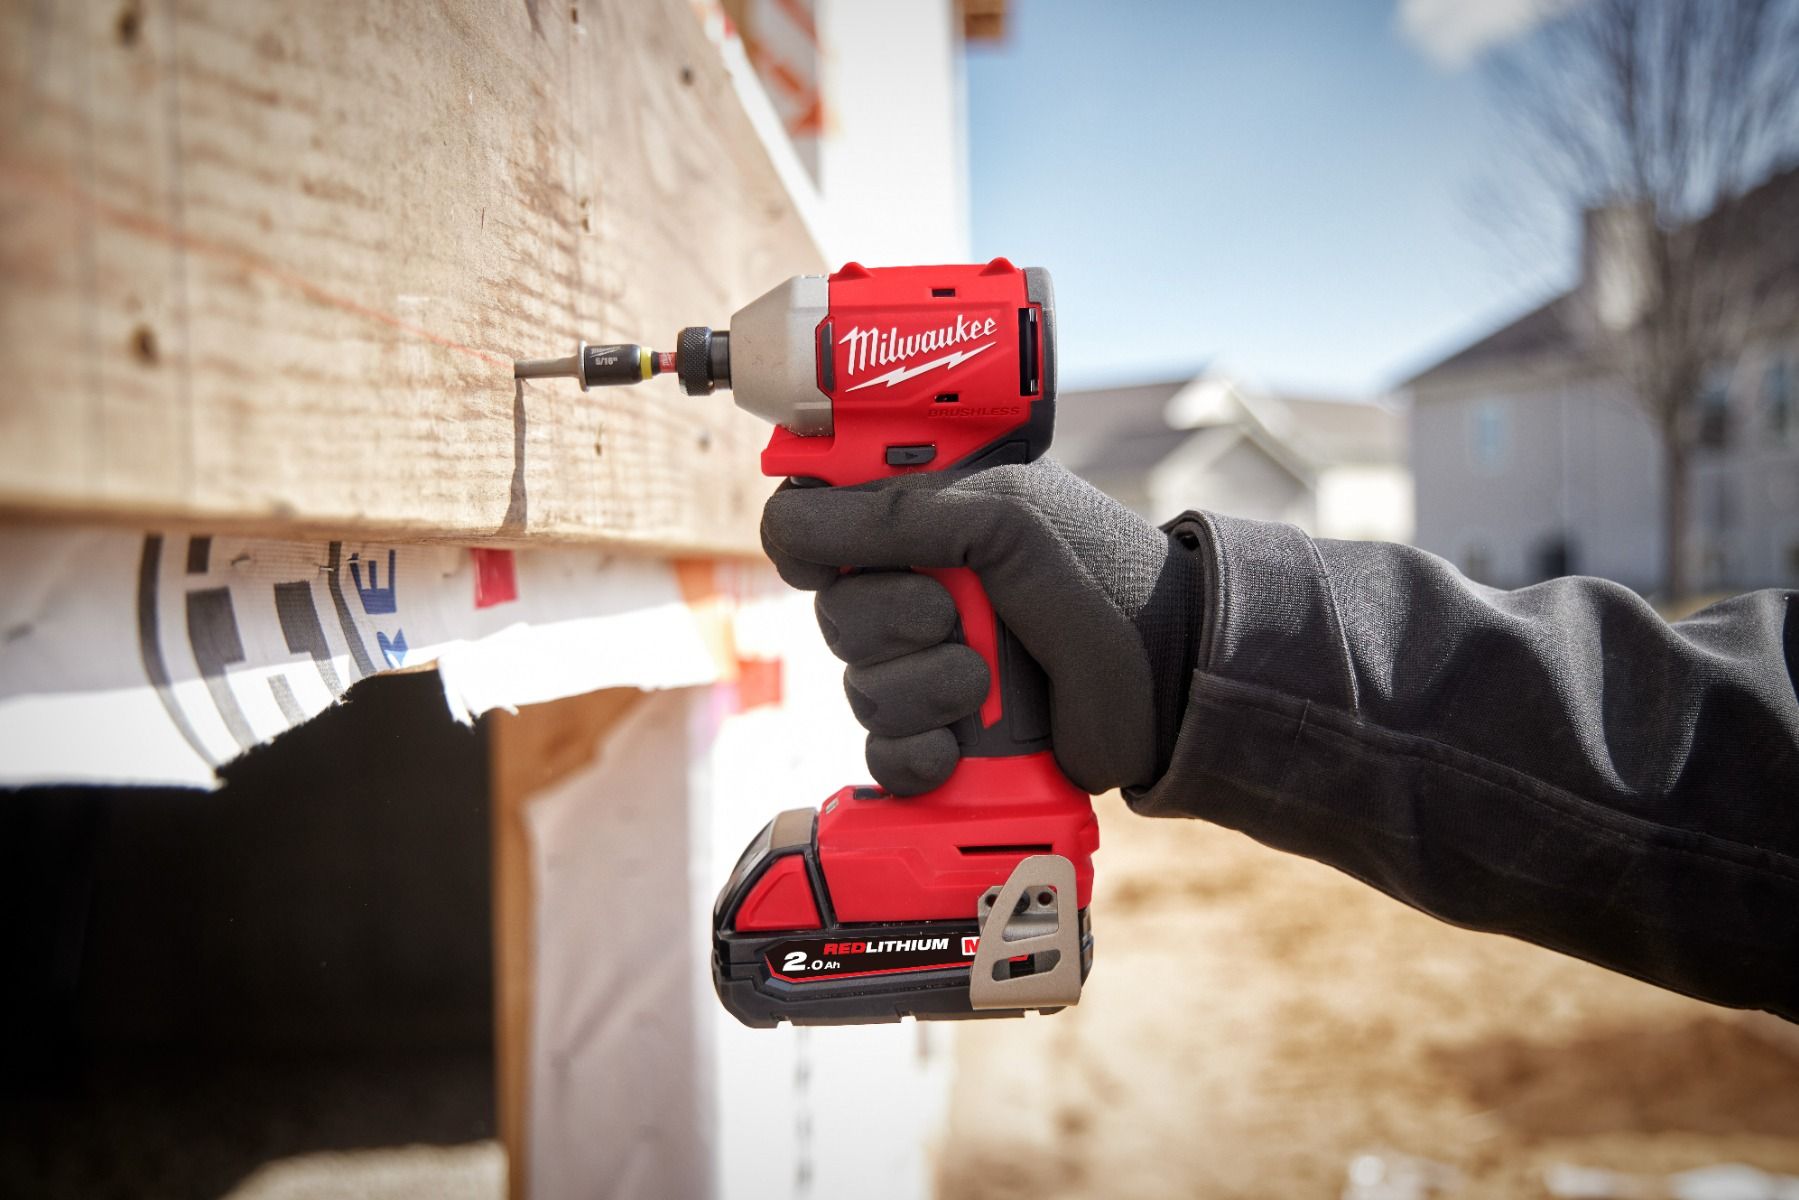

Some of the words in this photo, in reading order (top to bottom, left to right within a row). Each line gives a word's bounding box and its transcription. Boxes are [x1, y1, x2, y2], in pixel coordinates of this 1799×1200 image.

[838, 313, 998, 376] Milwaukee
[928, 406, 1021, 418] BRUSHLESS
[823, 937, 949, 956] REDLITHIUM
